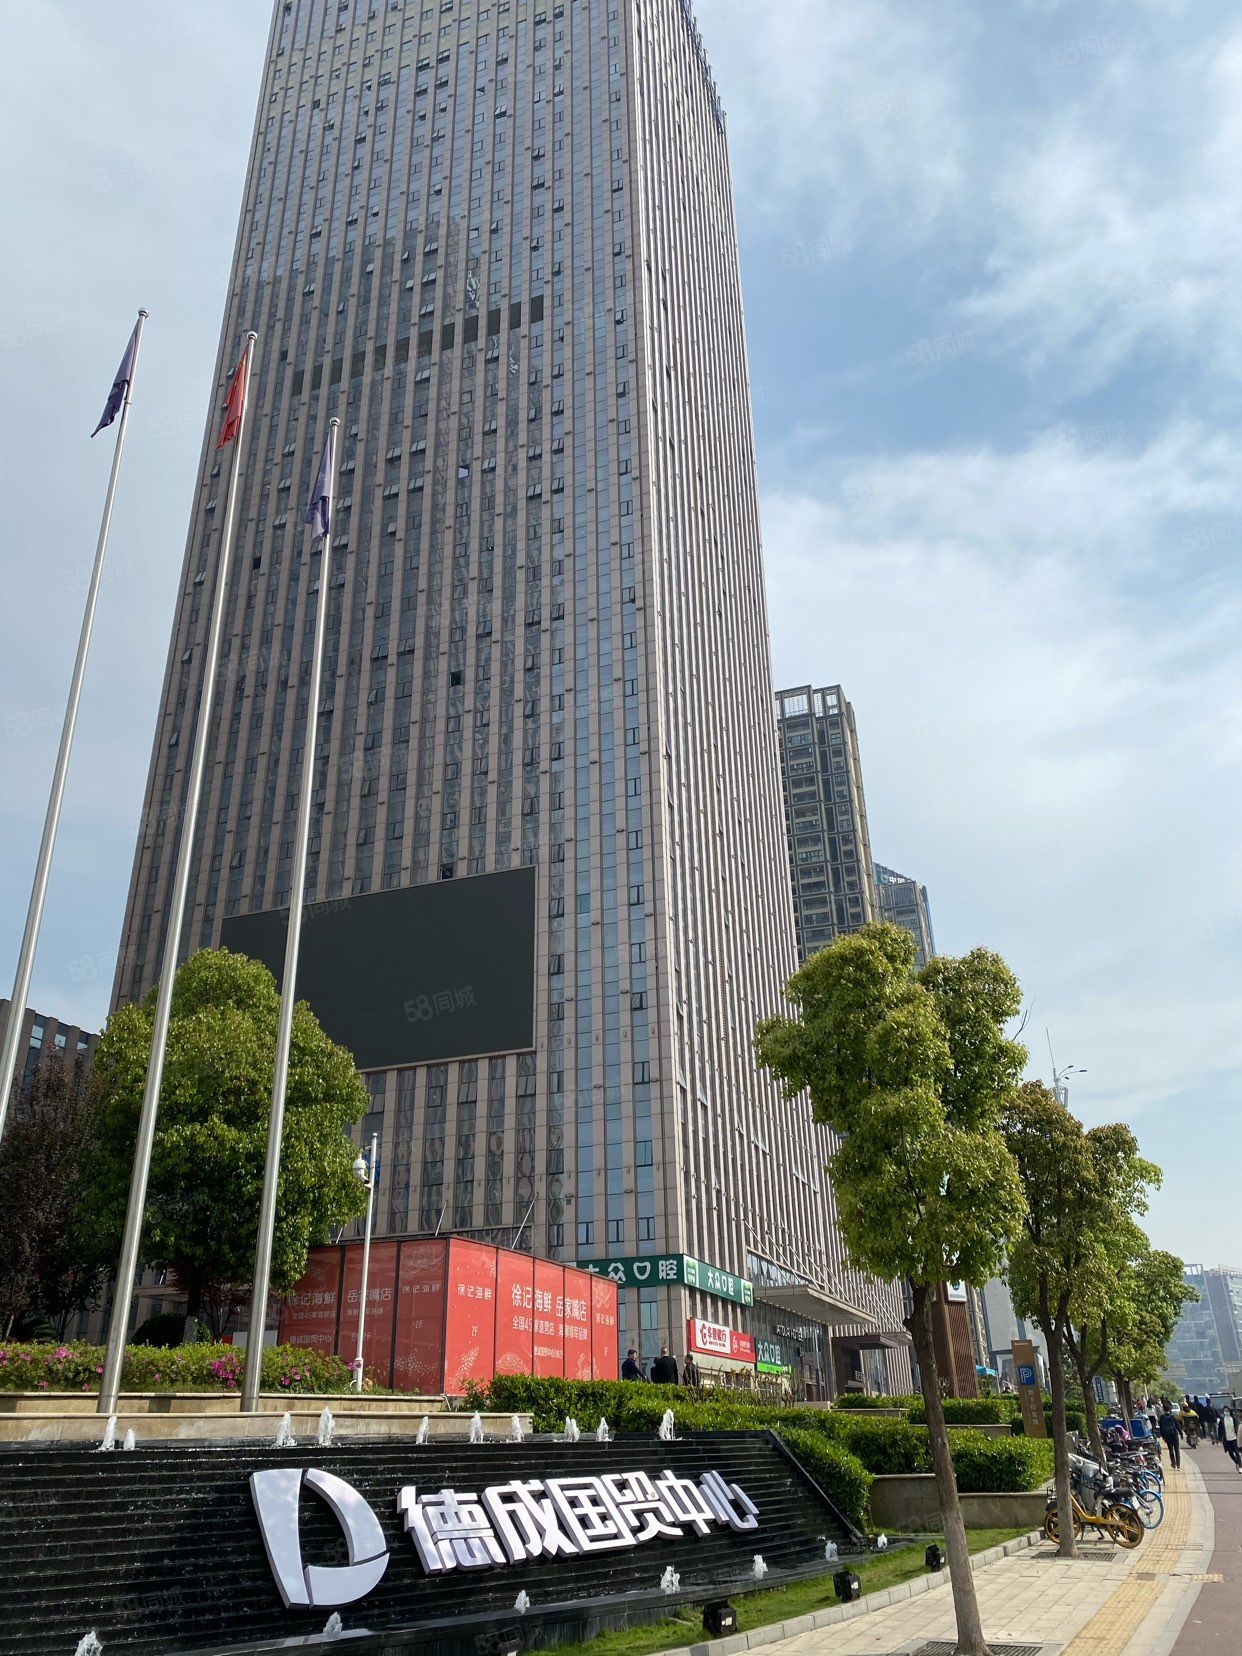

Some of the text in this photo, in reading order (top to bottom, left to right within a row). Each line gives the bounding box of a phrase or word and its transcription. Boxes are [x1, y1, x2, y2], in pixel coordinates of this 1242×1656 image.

[457, 1284, 492, 1300] 徐记海鲜
[707, 1269, 734, 1296] 大众口腔
[288, 1291, 336, 1308] 徐记海鲜
[511, 1284, 587, 1322] 徐记海鲜 岳家嘴店
[512, 1315, 555, 1336] 全国45家直营店
[707, 1326, 727, 1343] 华夏银行
[757, 1340, 782, 1365] 大众口腔
[397, 1470, 760, 1575] 德成国贸中心
